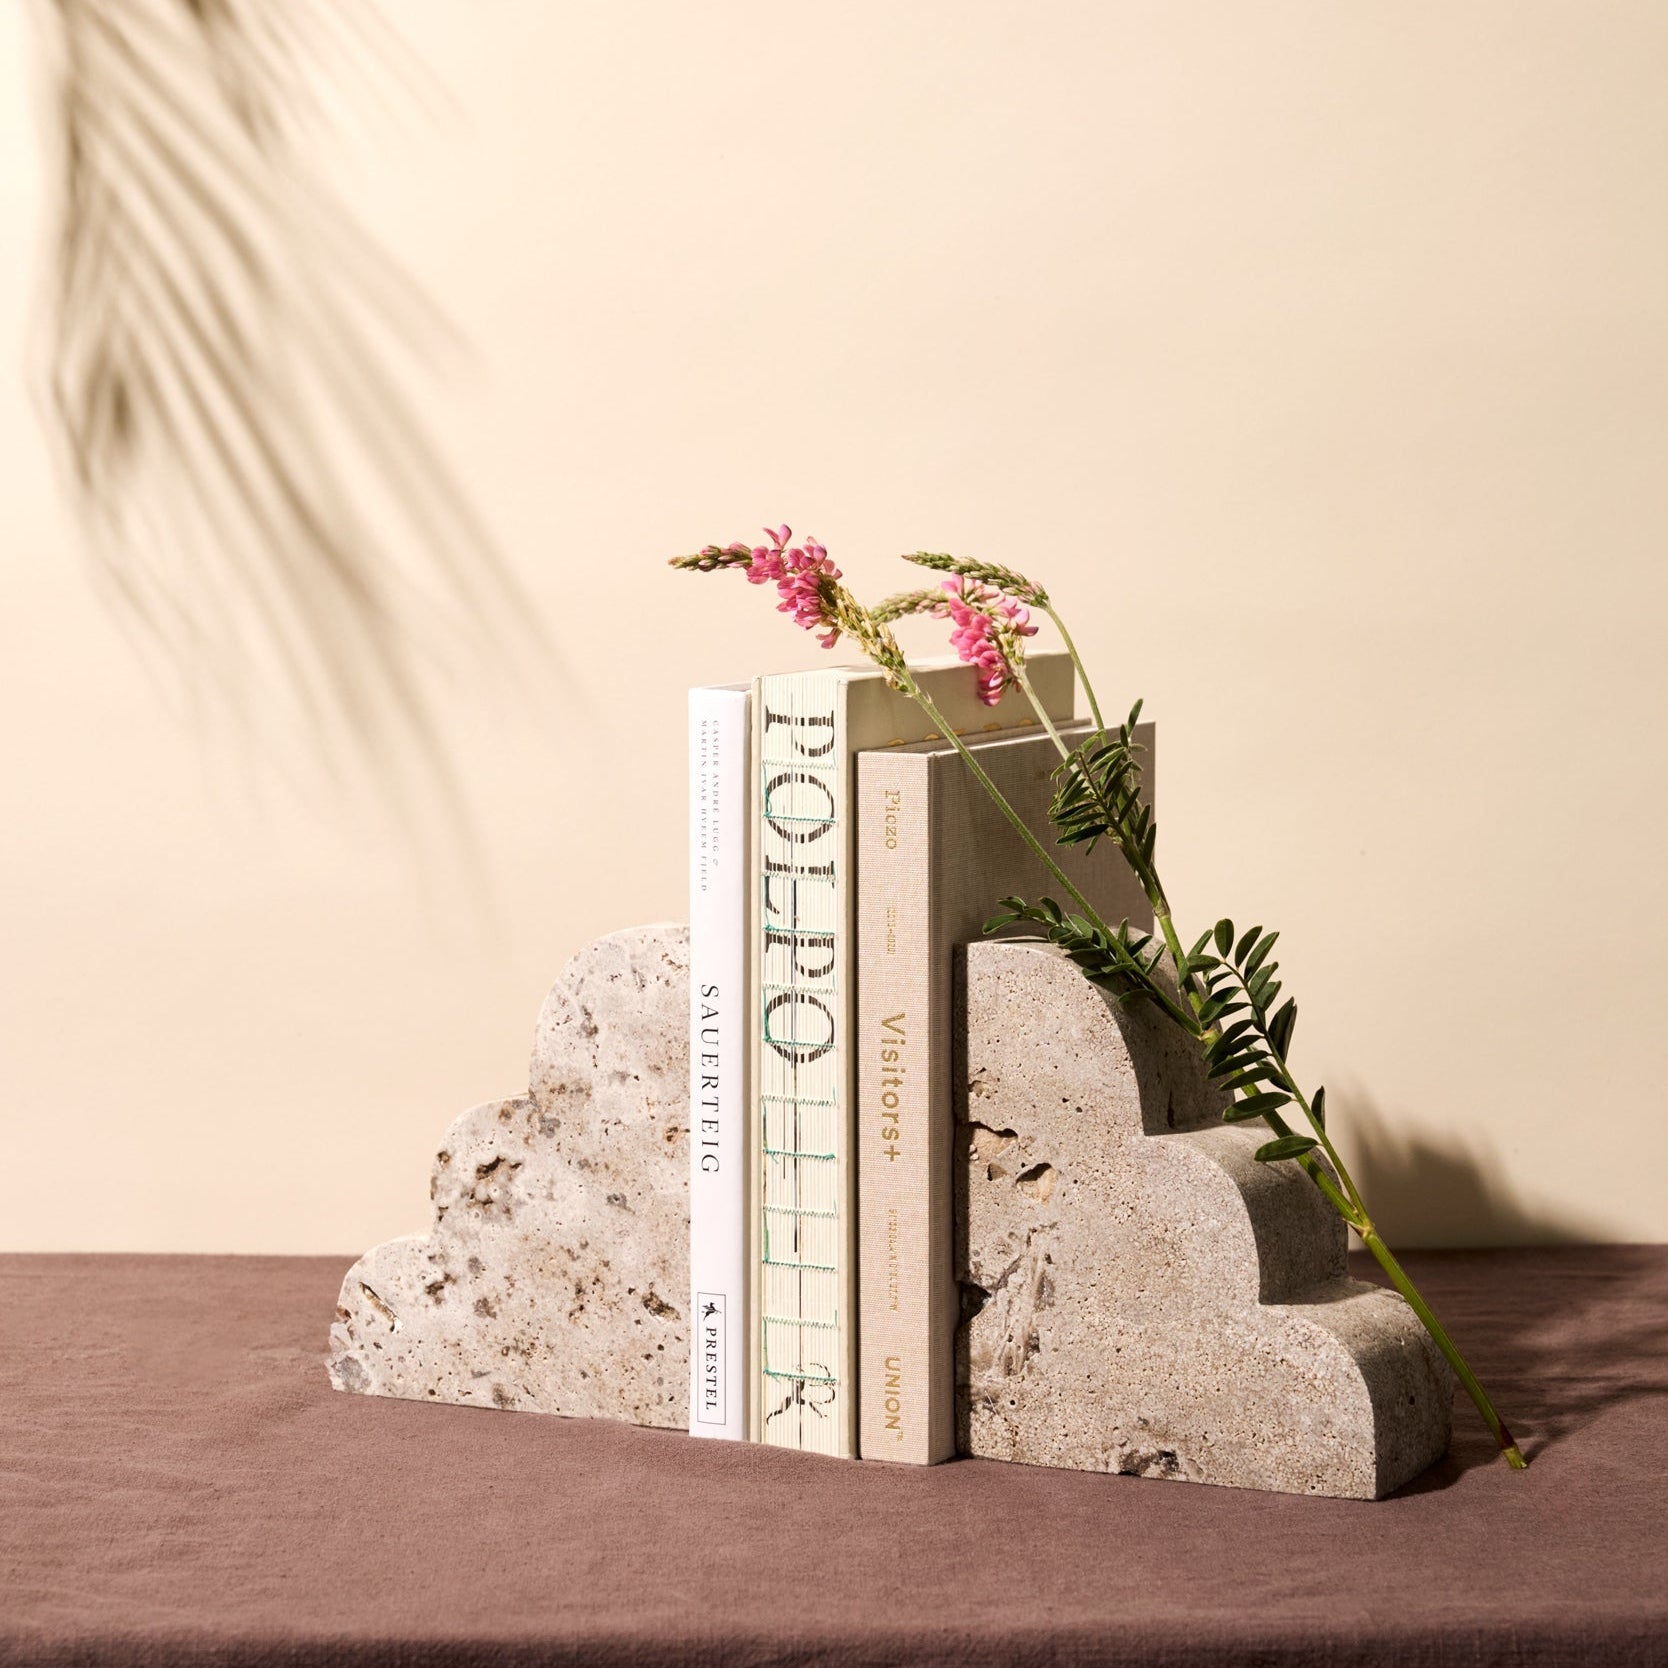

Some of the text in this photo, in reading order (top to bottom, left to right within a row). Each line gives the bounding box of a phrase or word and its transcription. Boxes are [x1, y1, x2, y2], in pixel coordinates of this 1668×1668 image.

[700, 720, 708, 767] MARTIN
[712, 720, 720, 766] CASPER
[700, 774, 708, 802] IVAR
[712, 820, 720, 852] LUGG
[885, 790, 901, 850] Piczo
[765, 705, 836, 1064] POLPO
[701, 984, 720, 1173] SAUERTEIG
[881, 1012, 906, 1162] Visitors+
[705, 1327, 717, 1410] PRESTEL
